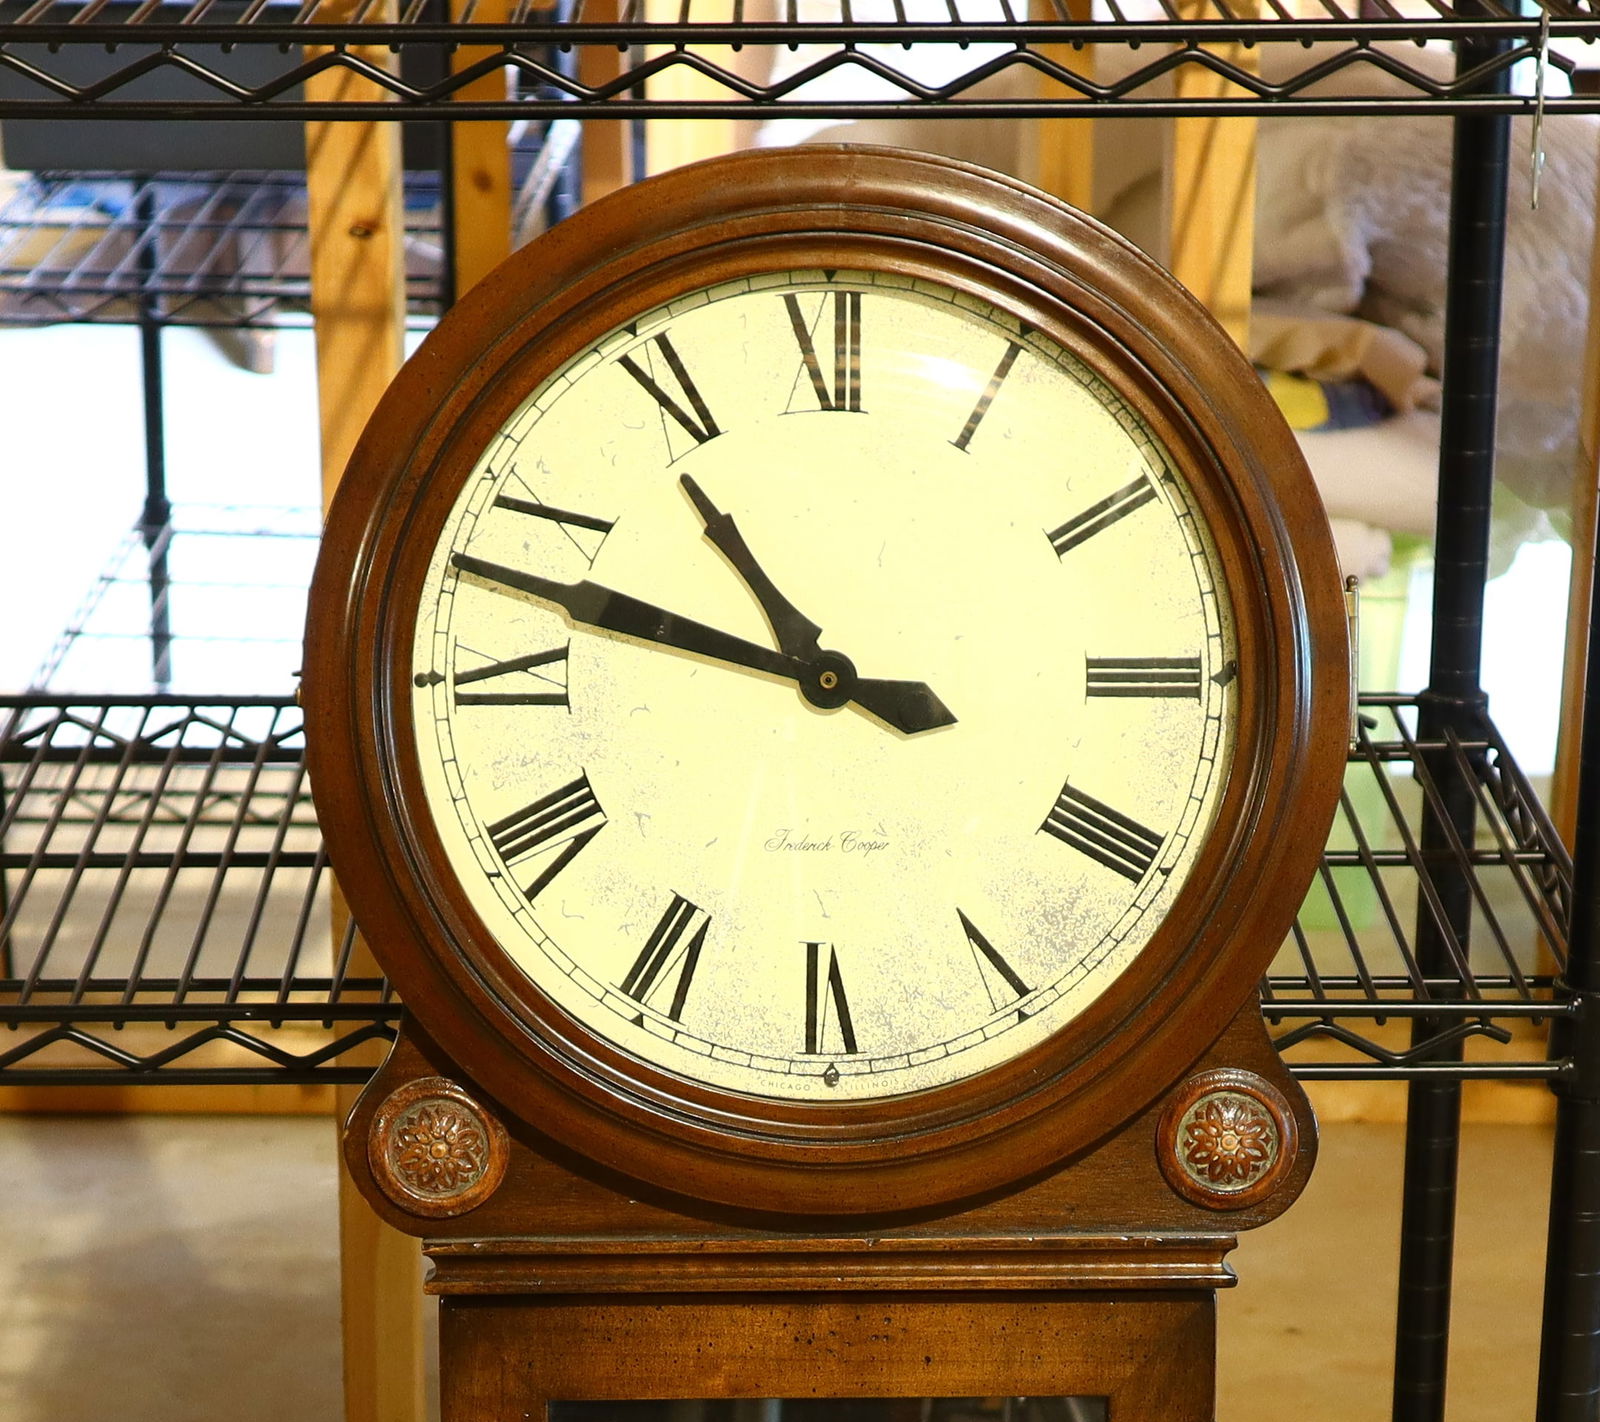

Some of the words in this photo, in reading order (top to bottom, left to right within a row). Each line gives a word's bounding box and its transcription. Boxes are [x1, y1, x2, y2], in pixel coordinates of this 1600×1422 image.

[609, 327, 729, 469] XI
[776, 290, 869, 416] XII
[946, 336, 1031, 455] I
[488, 462, 620, 571] X
[1042, 466, 1163, 564] II
[453, 634, 571, 715] IX
[1085, 649, 1203, 706] III
[481, 766, 609, 911] VIII
[839, 830, 890, 858] Cooper
[1035, 774, 1169, 889] IIII
[609, 889, 712, 1026] VII
[795, 941, 868, 1056] VI
[956, 906, 1038, 1016] V
[760, 1079, 812, 1091] CHICAGO
